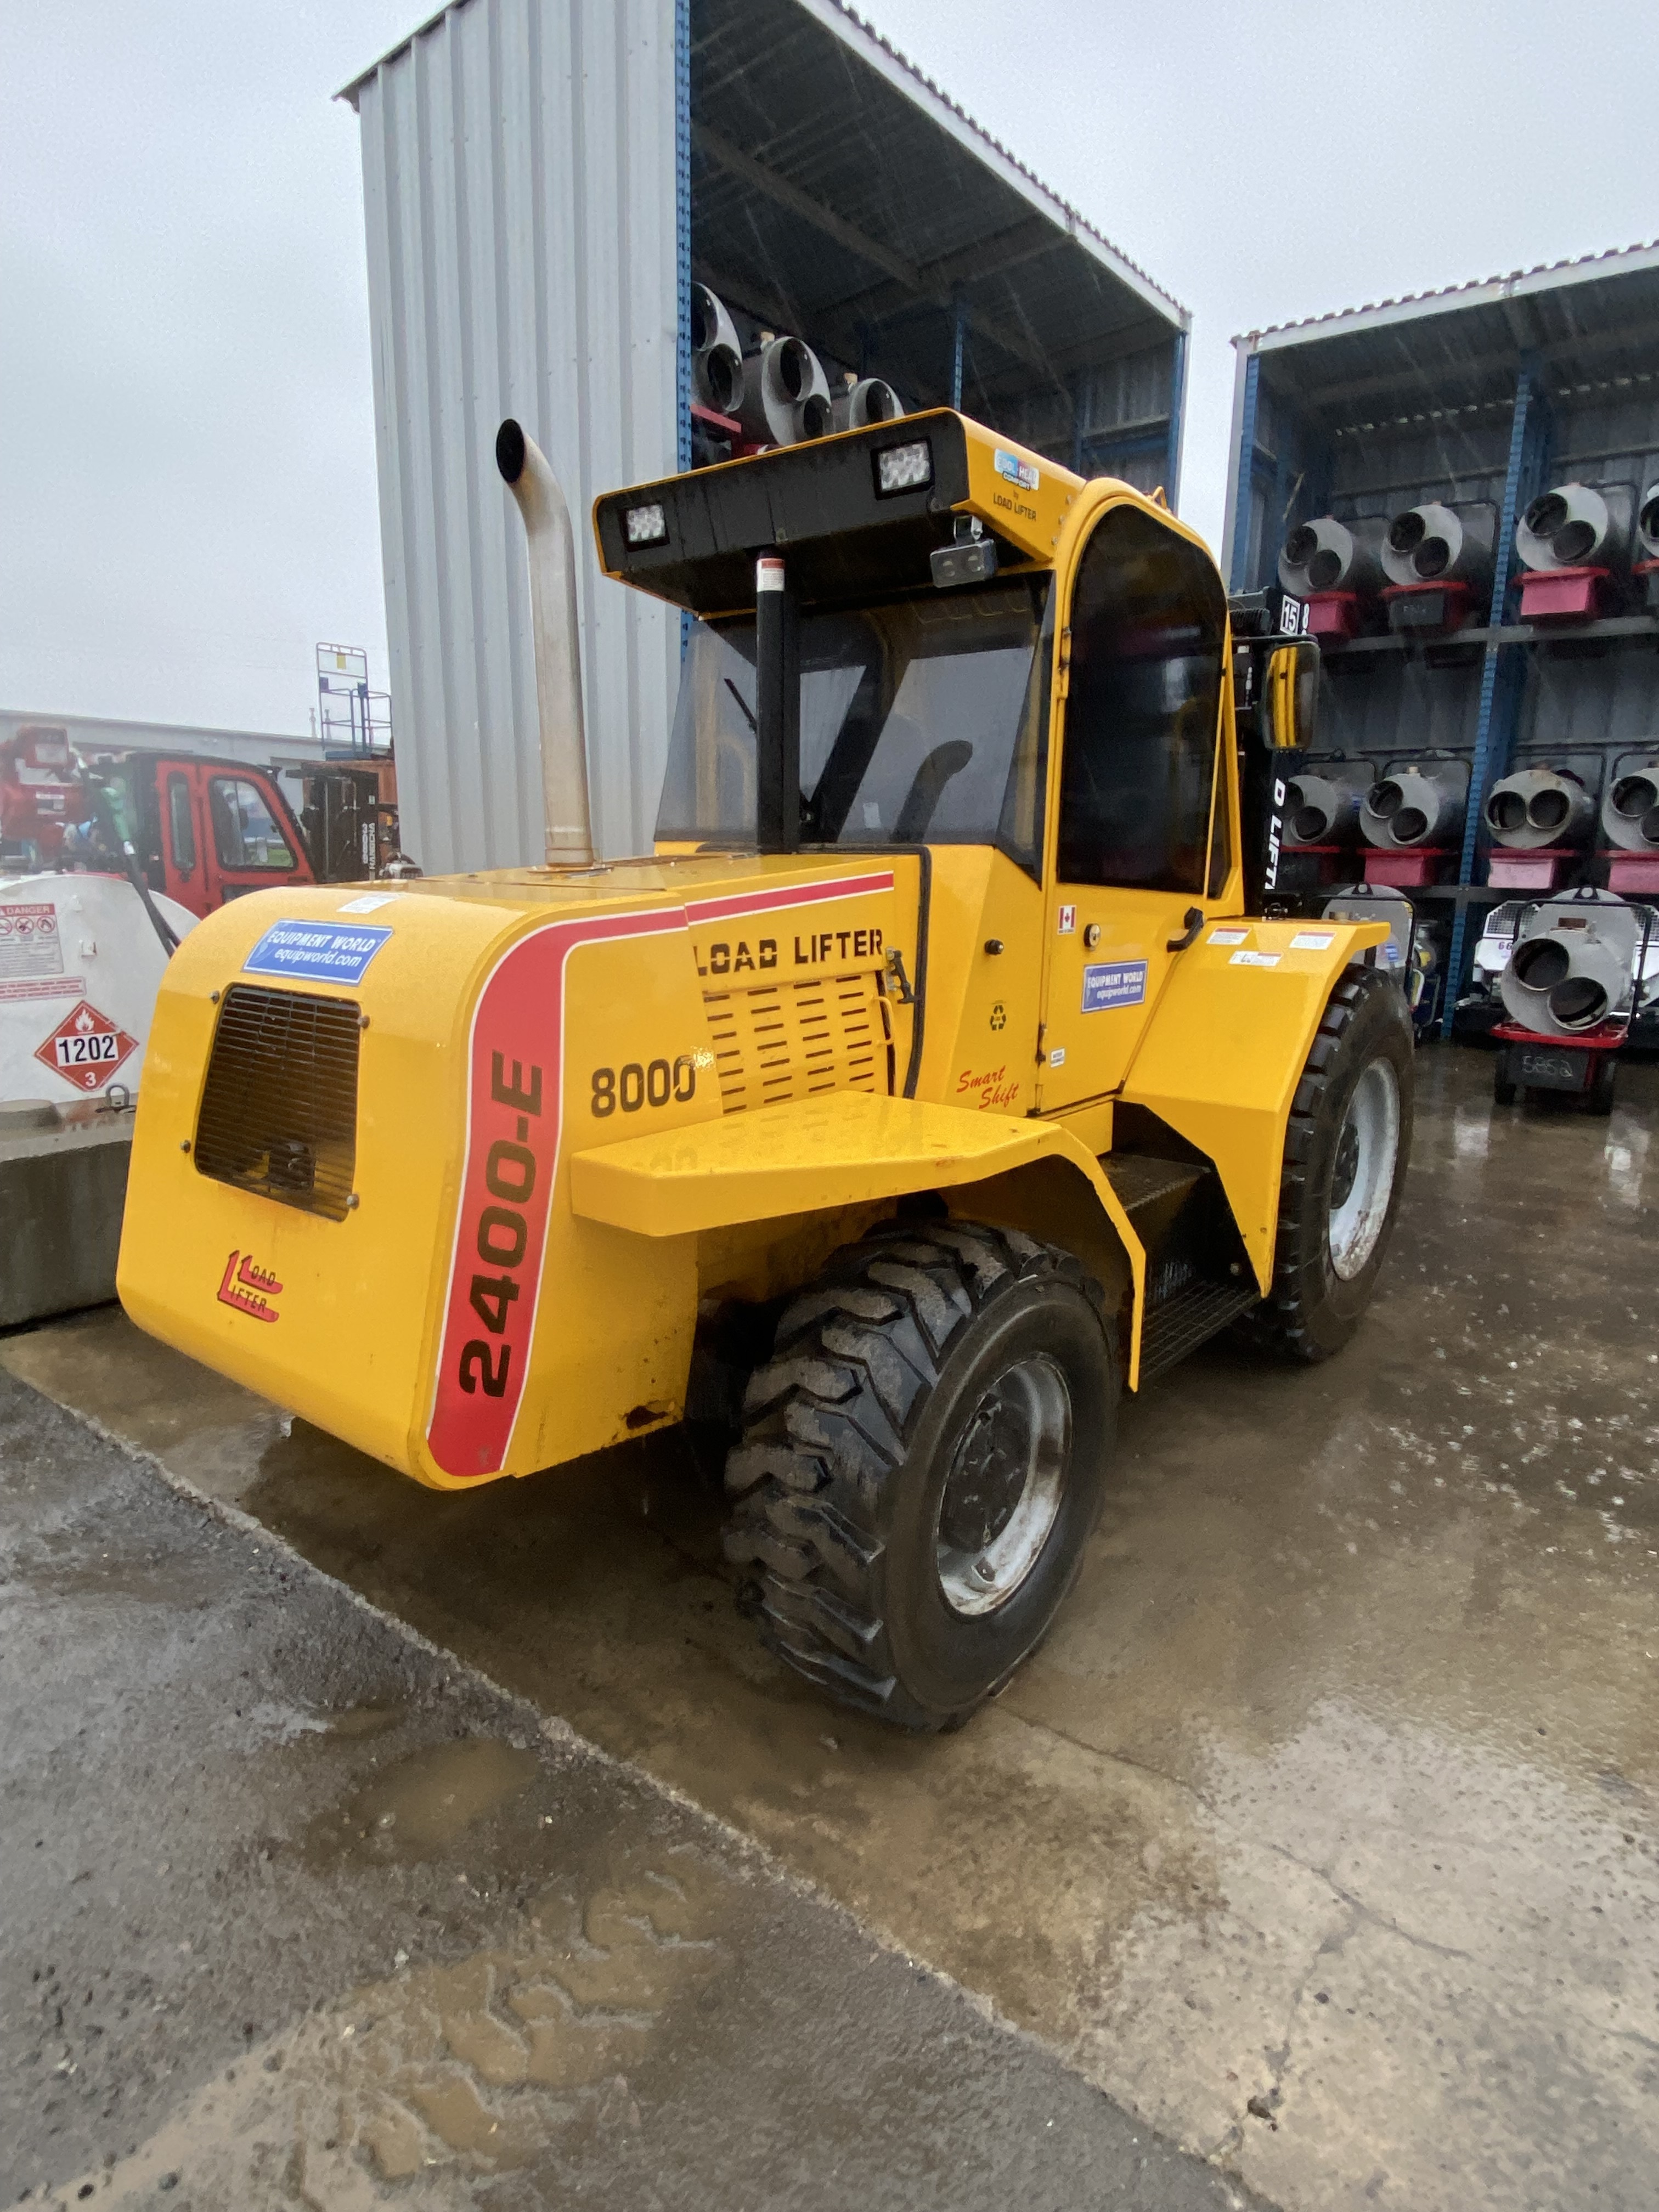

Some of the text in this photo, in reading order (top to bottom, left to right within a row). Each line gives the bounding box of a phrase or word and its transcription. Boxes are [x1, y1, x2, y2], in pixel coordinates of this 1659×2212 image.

[994, 492, 1037, 522] LOAD LIFTER
[1284, 603, 1297, 632] 15
[6, 905, 50, 915] DANGER
[267, 930, 376, 952] EQUIPMENT WORLD
[693, 929, 883, 977] LOAD LIFTER
[274, 947, 362, 967] equipworld.com
[59, 1035, 116, 1064] 1202
[84, 1071, 97, 1087] 3
[591, 1054, 696, 1118] 8000
[956, 1065, 1006, 1093] Smart
[978, 1083, 1019, 1109] Shift
[459, 1049, 543, 1398] 2400-E
